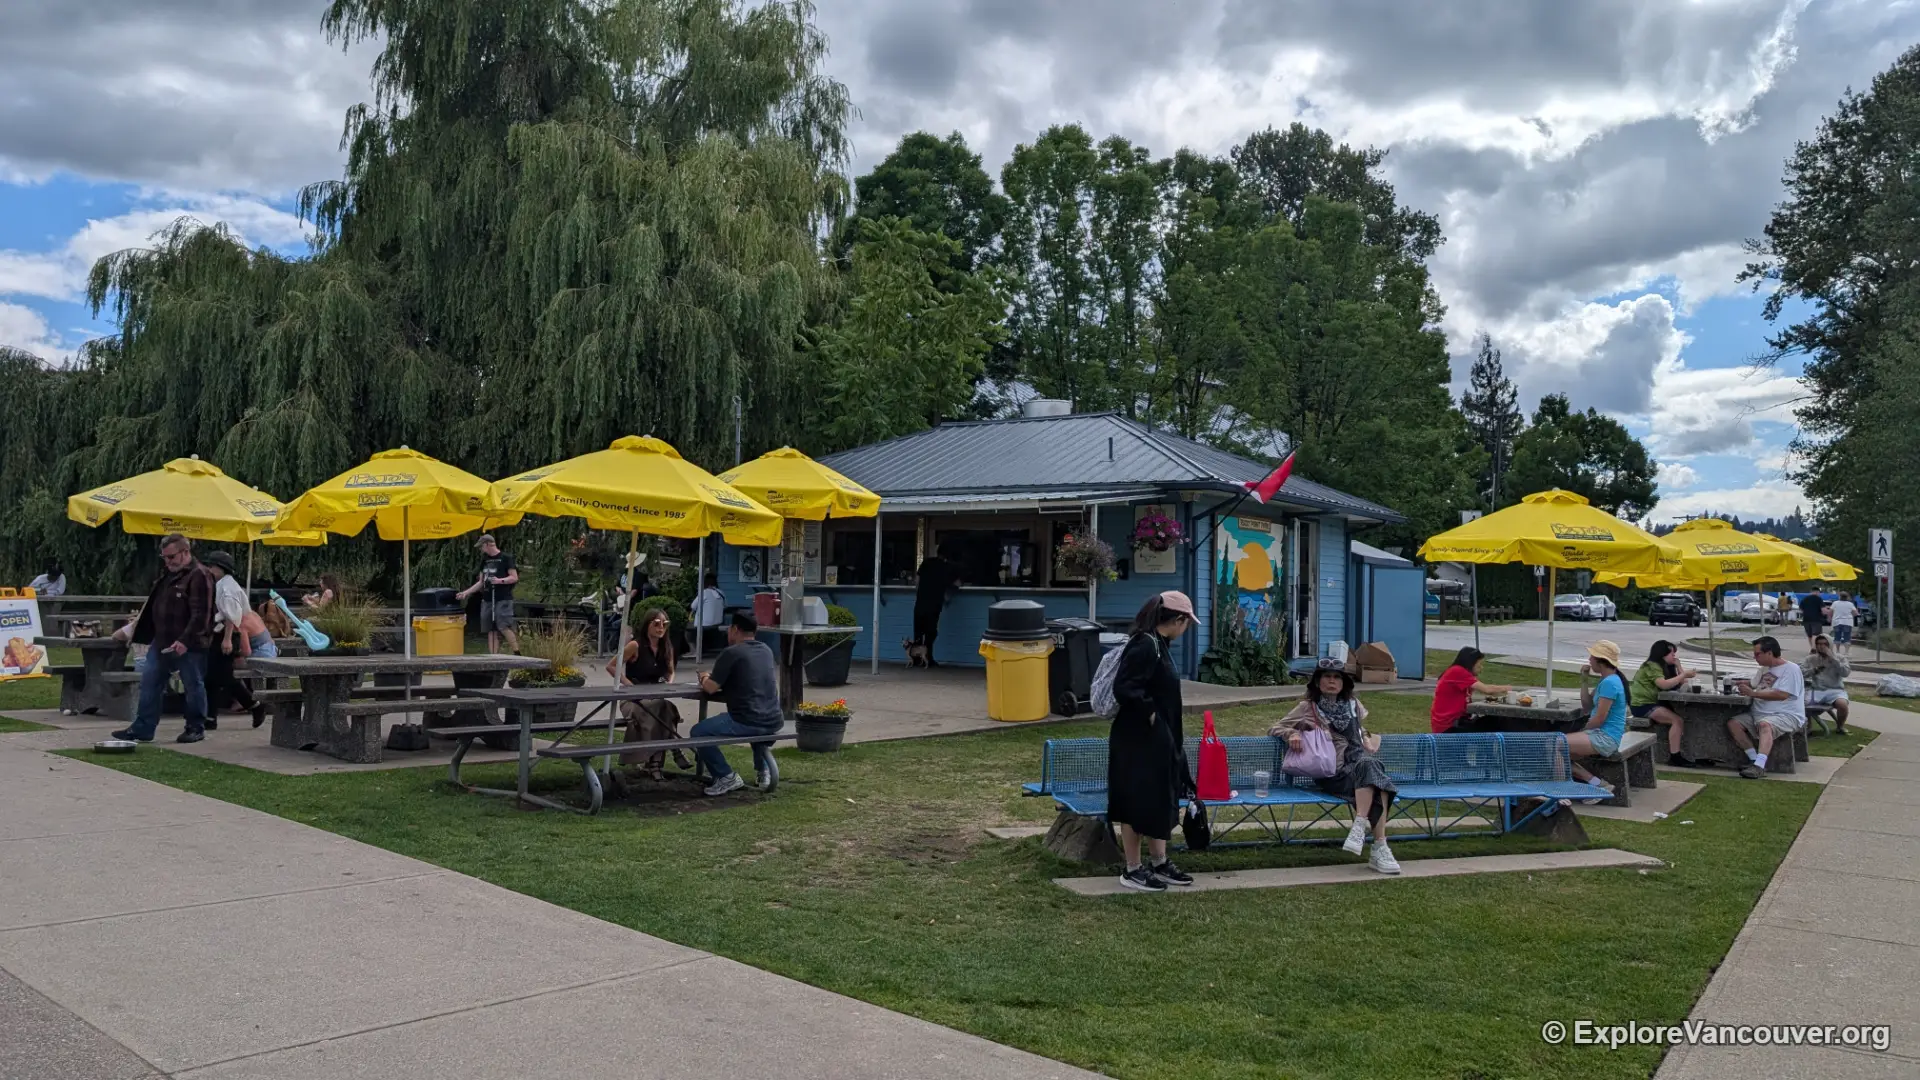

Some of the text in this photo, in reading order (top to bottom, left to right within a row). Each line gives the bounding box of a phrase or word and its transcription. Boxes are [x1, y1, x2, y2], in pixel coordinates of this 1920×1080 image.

[554, 494, 686, 519] Family-Owned Since 1985
[1, 616, 30, 626] OPEN
